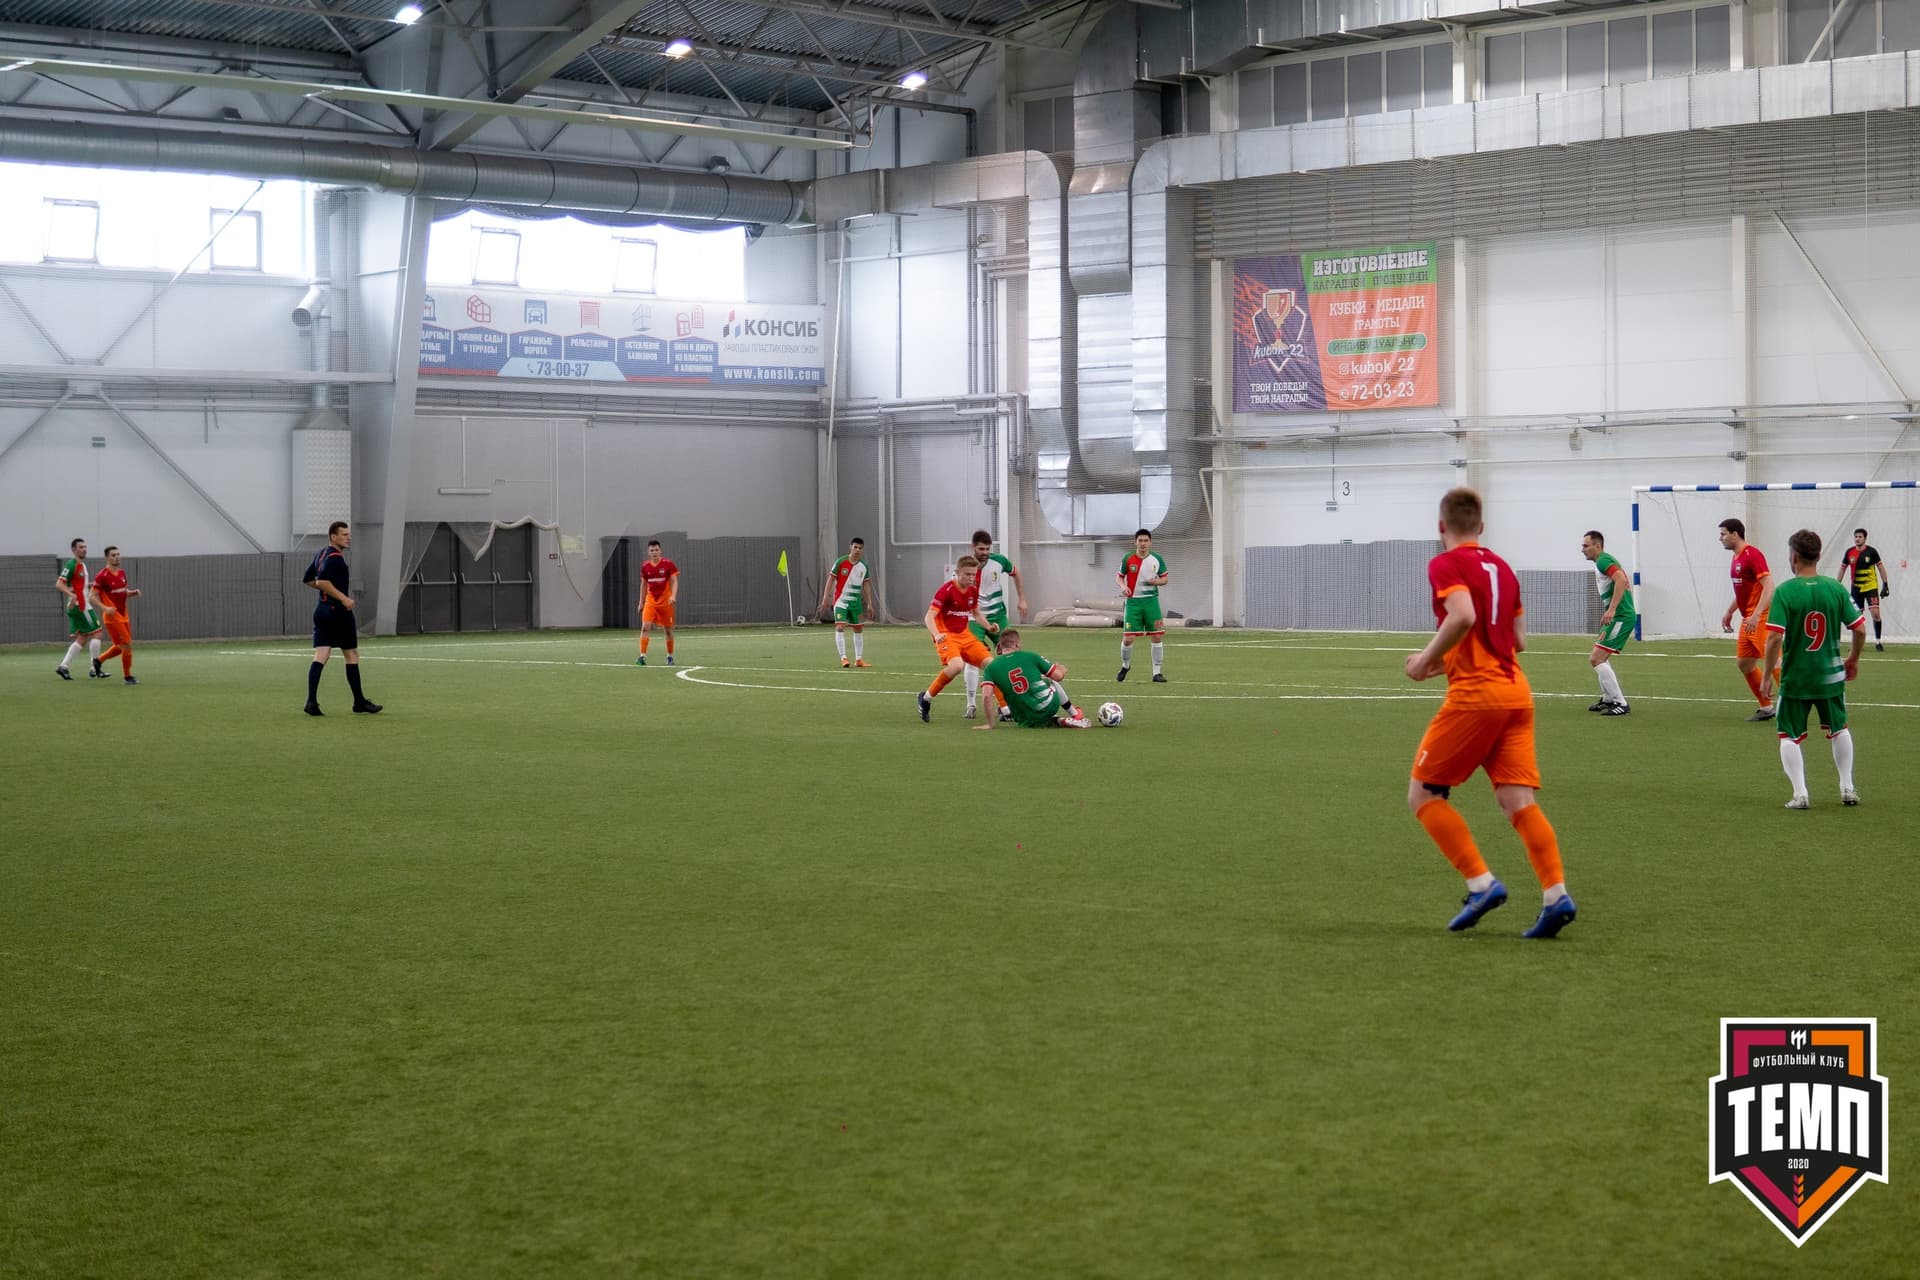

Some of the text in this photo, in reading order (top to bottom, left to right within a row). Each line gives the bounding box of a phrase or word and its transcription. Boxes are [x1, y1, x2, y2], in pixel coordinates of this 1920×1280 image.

[1313, 250, 1428, 276] ИЗГОТОВЛЕНИЕ
[1329, 296, 1425, 316] КУБКИ МЕДАЛИ
[744, 320, 818, 337] КОНСИБ
[1354, 316, 1400, 331] ГРАМОТЫ
[484, 334, 503, 344] САДЫ
[469, 344, 498, 354] ТЕРРАСЫ
[723, 342, 750, 353] ЗАВОДЫ
[752, 343, 799, 354] ПЛАСТИКОВЫХ
[537, 361, 589, 377] 73-00-37
[724, 367, 820, 381] www.konsib.com
[1249, 383, 1271, 393] ТВОИ
[1351, 381, 1415, 401] 72-03-23
[1249, 395, 1271, 404] ТВОИ
[1342, 481, 1351, 496] 3
[1480, 561, 1500, 626] 1
[1804, 610, 1827, 651] 9
[1008, 667, 1029, 695] 5
